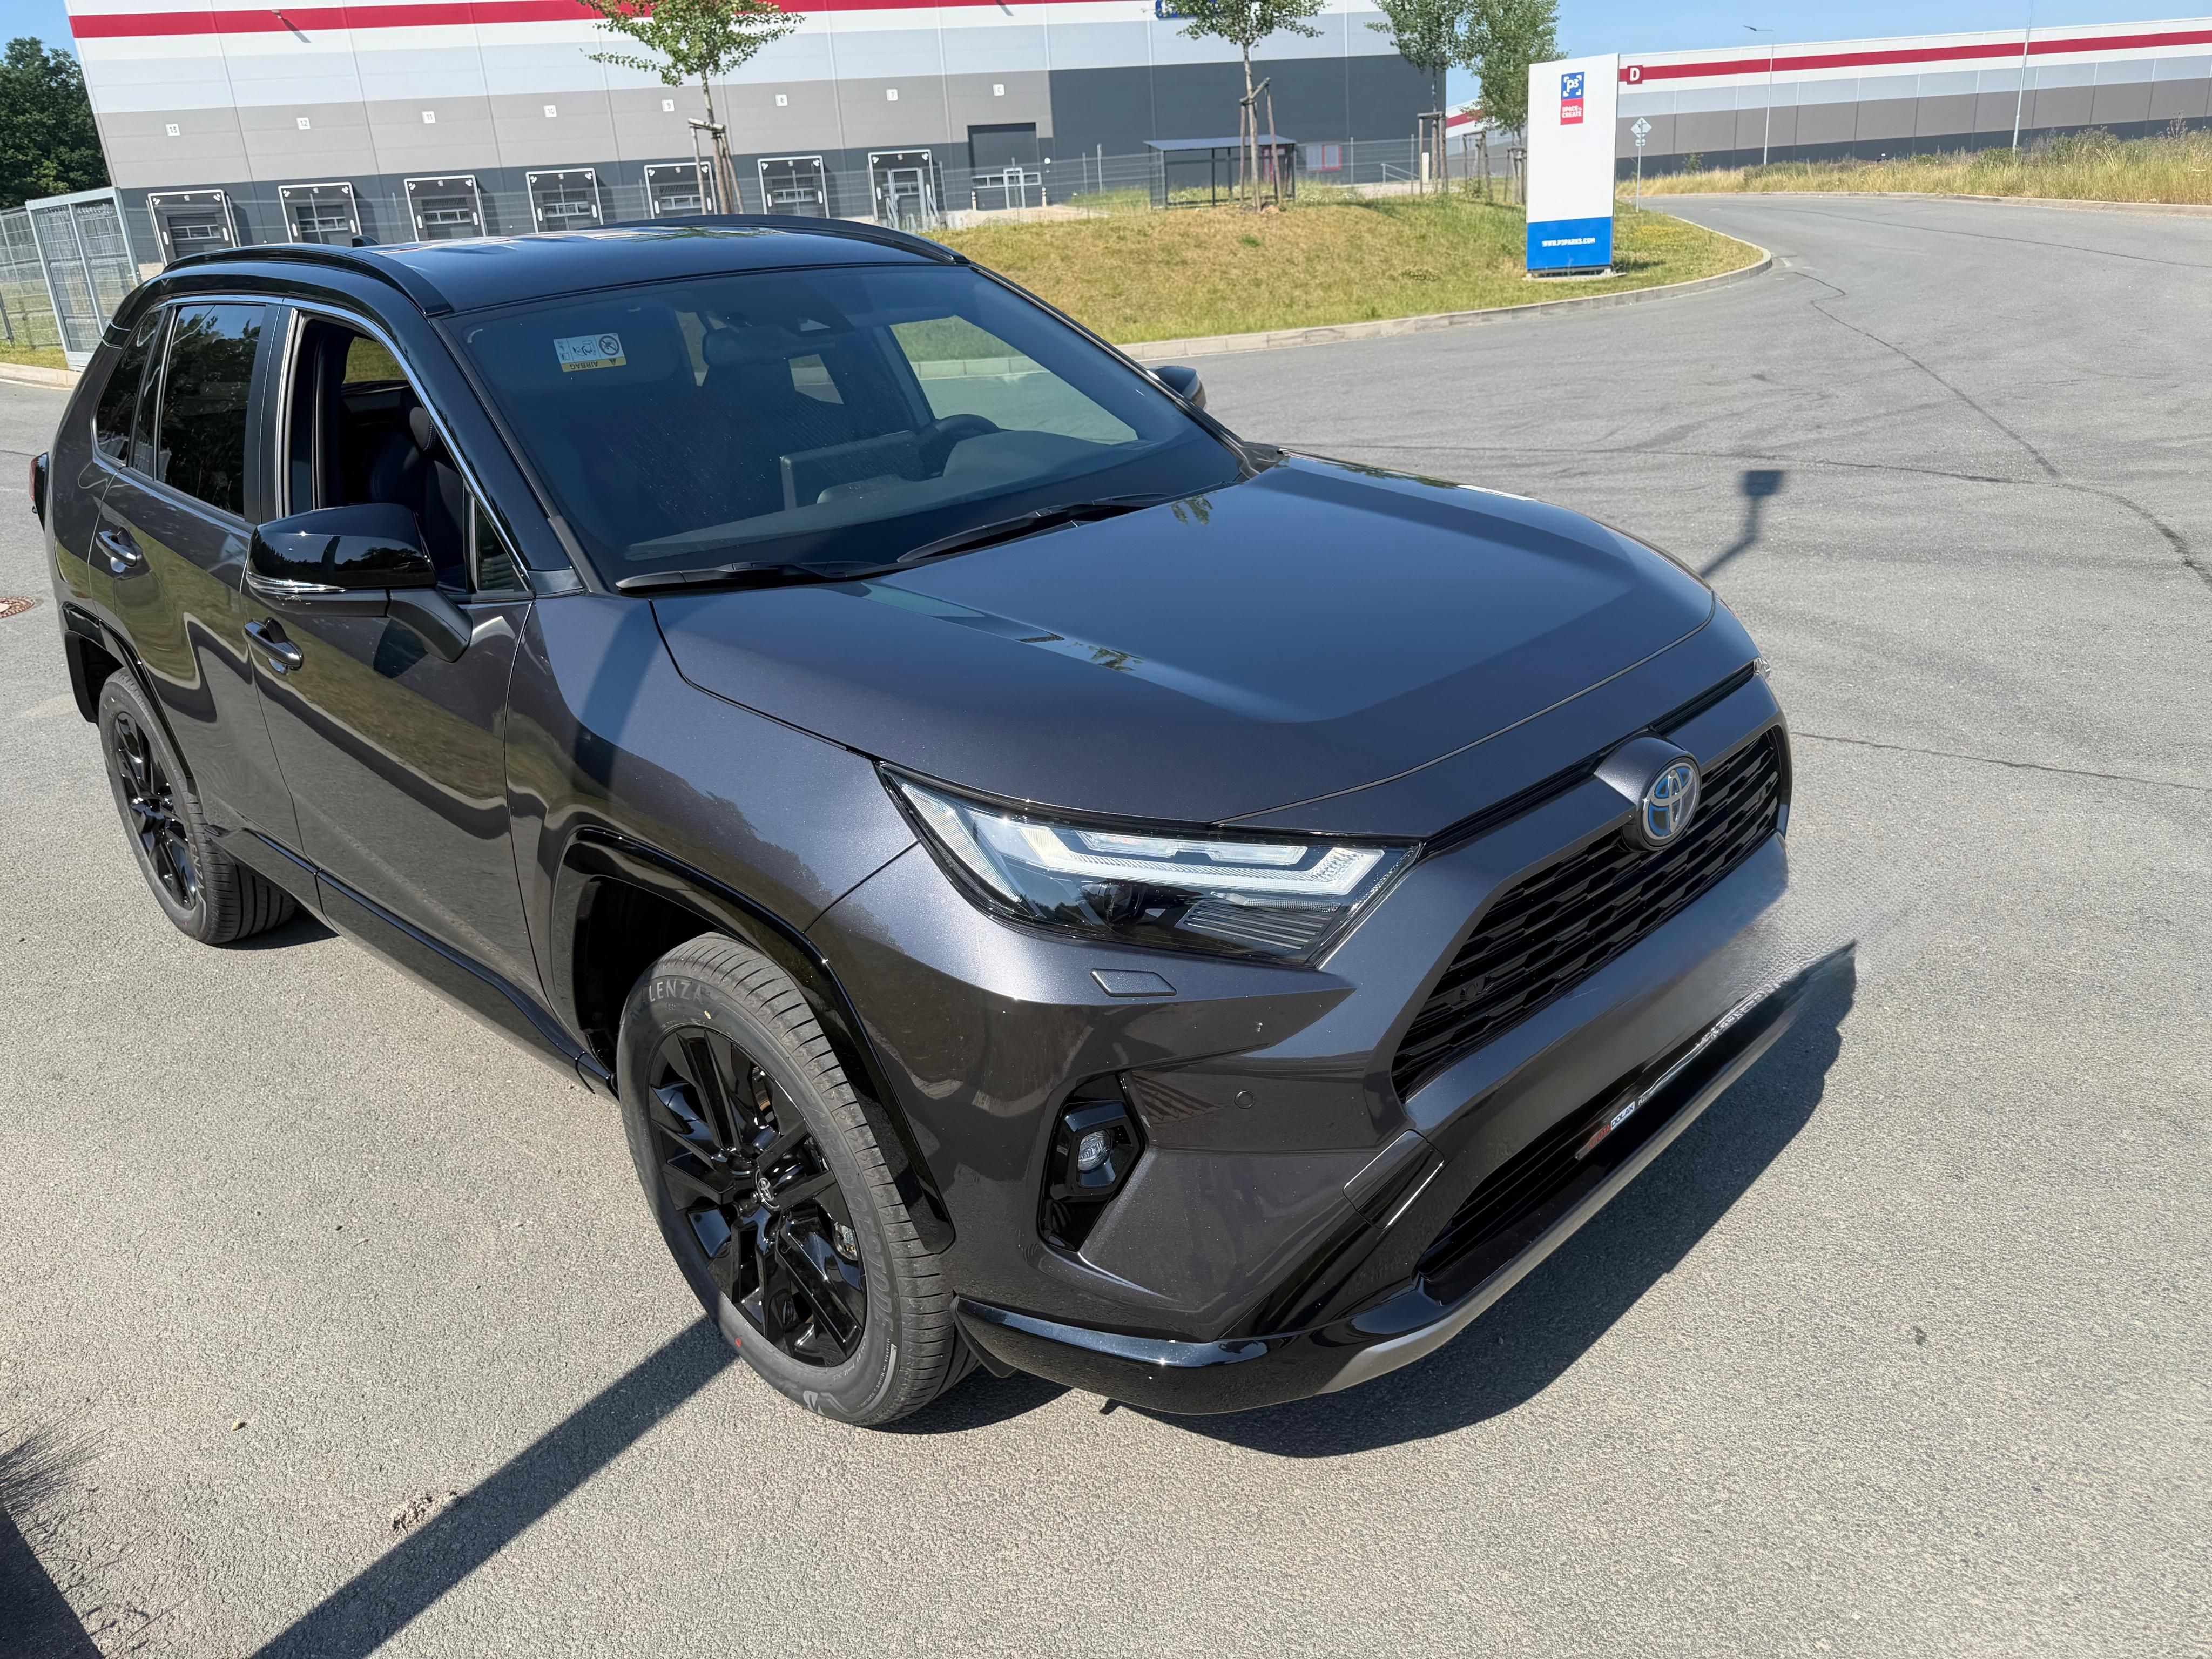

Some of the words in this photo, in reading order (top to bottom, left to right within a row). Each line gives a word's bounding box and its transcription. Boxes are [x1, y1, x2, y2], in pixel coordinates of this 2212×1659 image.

[1629, 68, 1640, 82] D
[570, 361, 598, 370] AIRBAG
[1611, 1104, 1634, 1127] DOLAK
